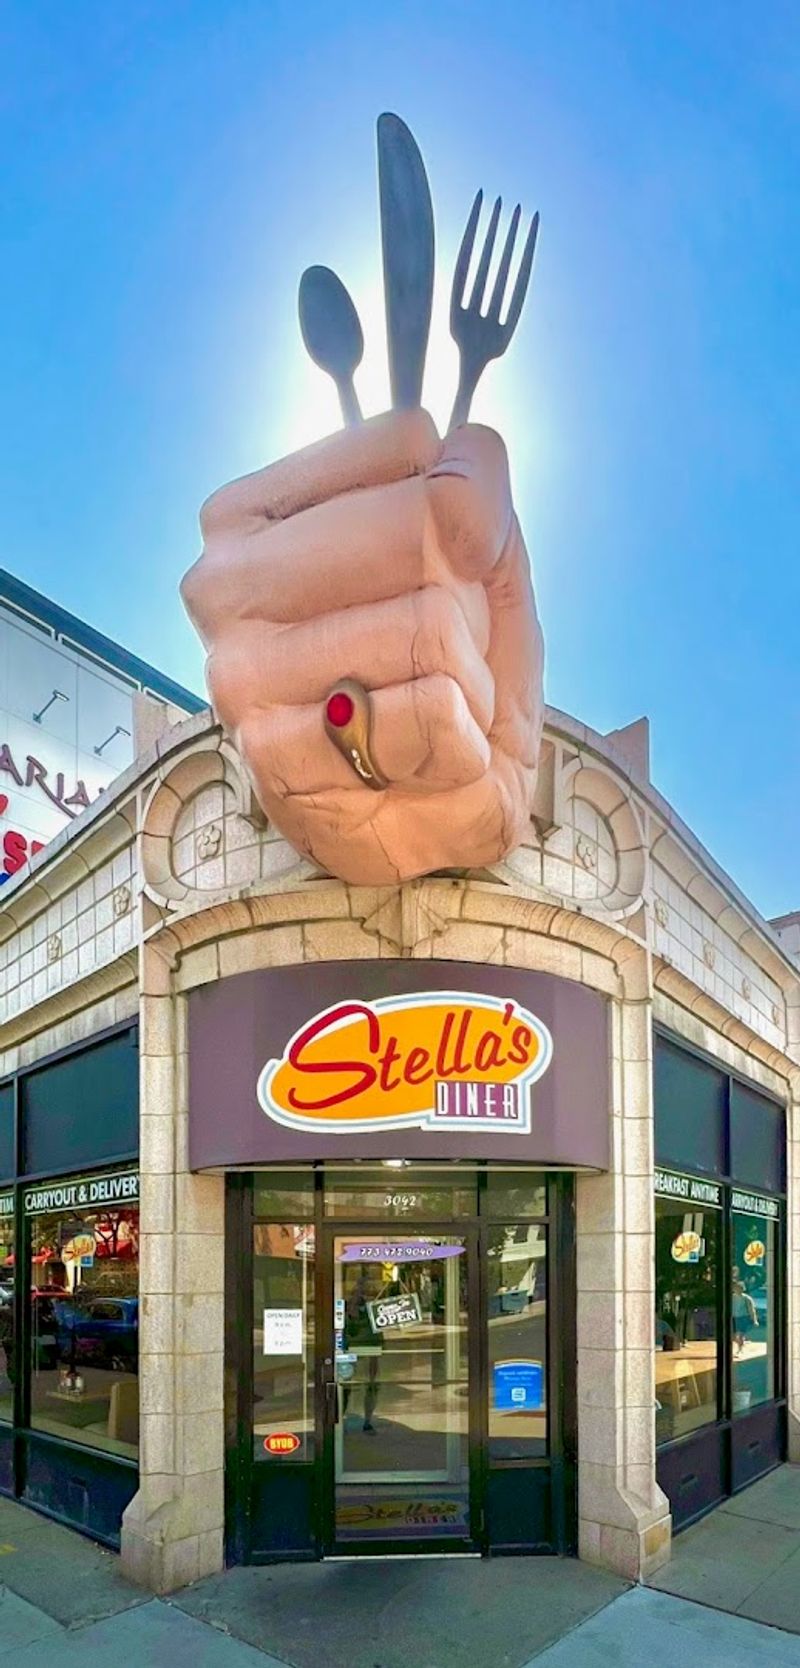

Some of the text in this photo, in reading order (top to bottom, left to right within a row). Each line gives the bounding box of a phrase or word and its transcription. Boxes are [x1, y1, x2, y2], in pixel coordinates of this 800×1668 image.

[288, 1003, 532, 1110] Stella's
[436, 1082, 518, 1118] DINER
[25, 1175, 140, 1210] CARRYOUT & DELIVER
[383, 1195, 416, 1206] 3042
[361, 1247, 380, 1257] 773
[376, 1309, 417, 1327] OPEN
[269, 1438, 294, 1450] BYOB
